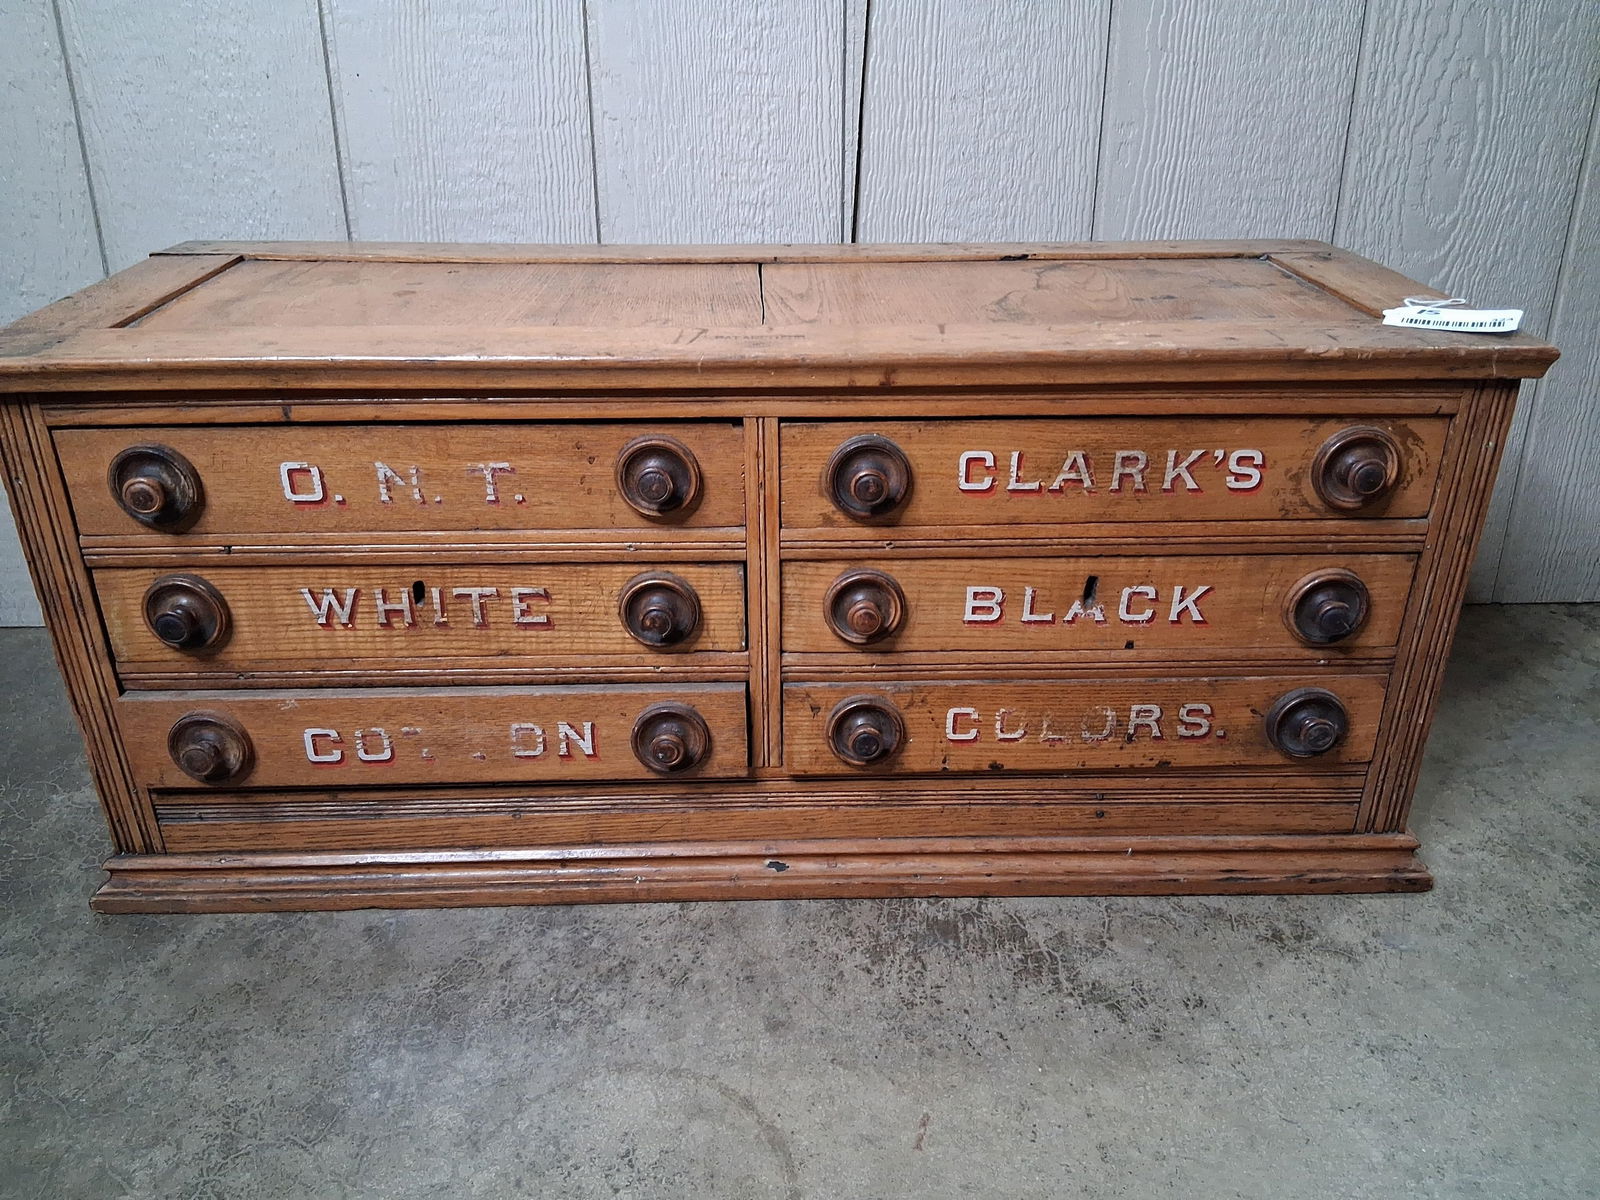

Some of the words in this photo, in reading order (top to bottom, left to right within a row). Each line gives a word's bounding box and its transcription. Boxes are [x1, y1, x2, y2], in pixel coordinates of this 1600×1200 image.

[957, 449, 1267, 497] CLARK'S
[300, 586, 555, 631] WHITE
[963, 585, 1215, 627] BLACK
[303, 720, 602, 770] COON
